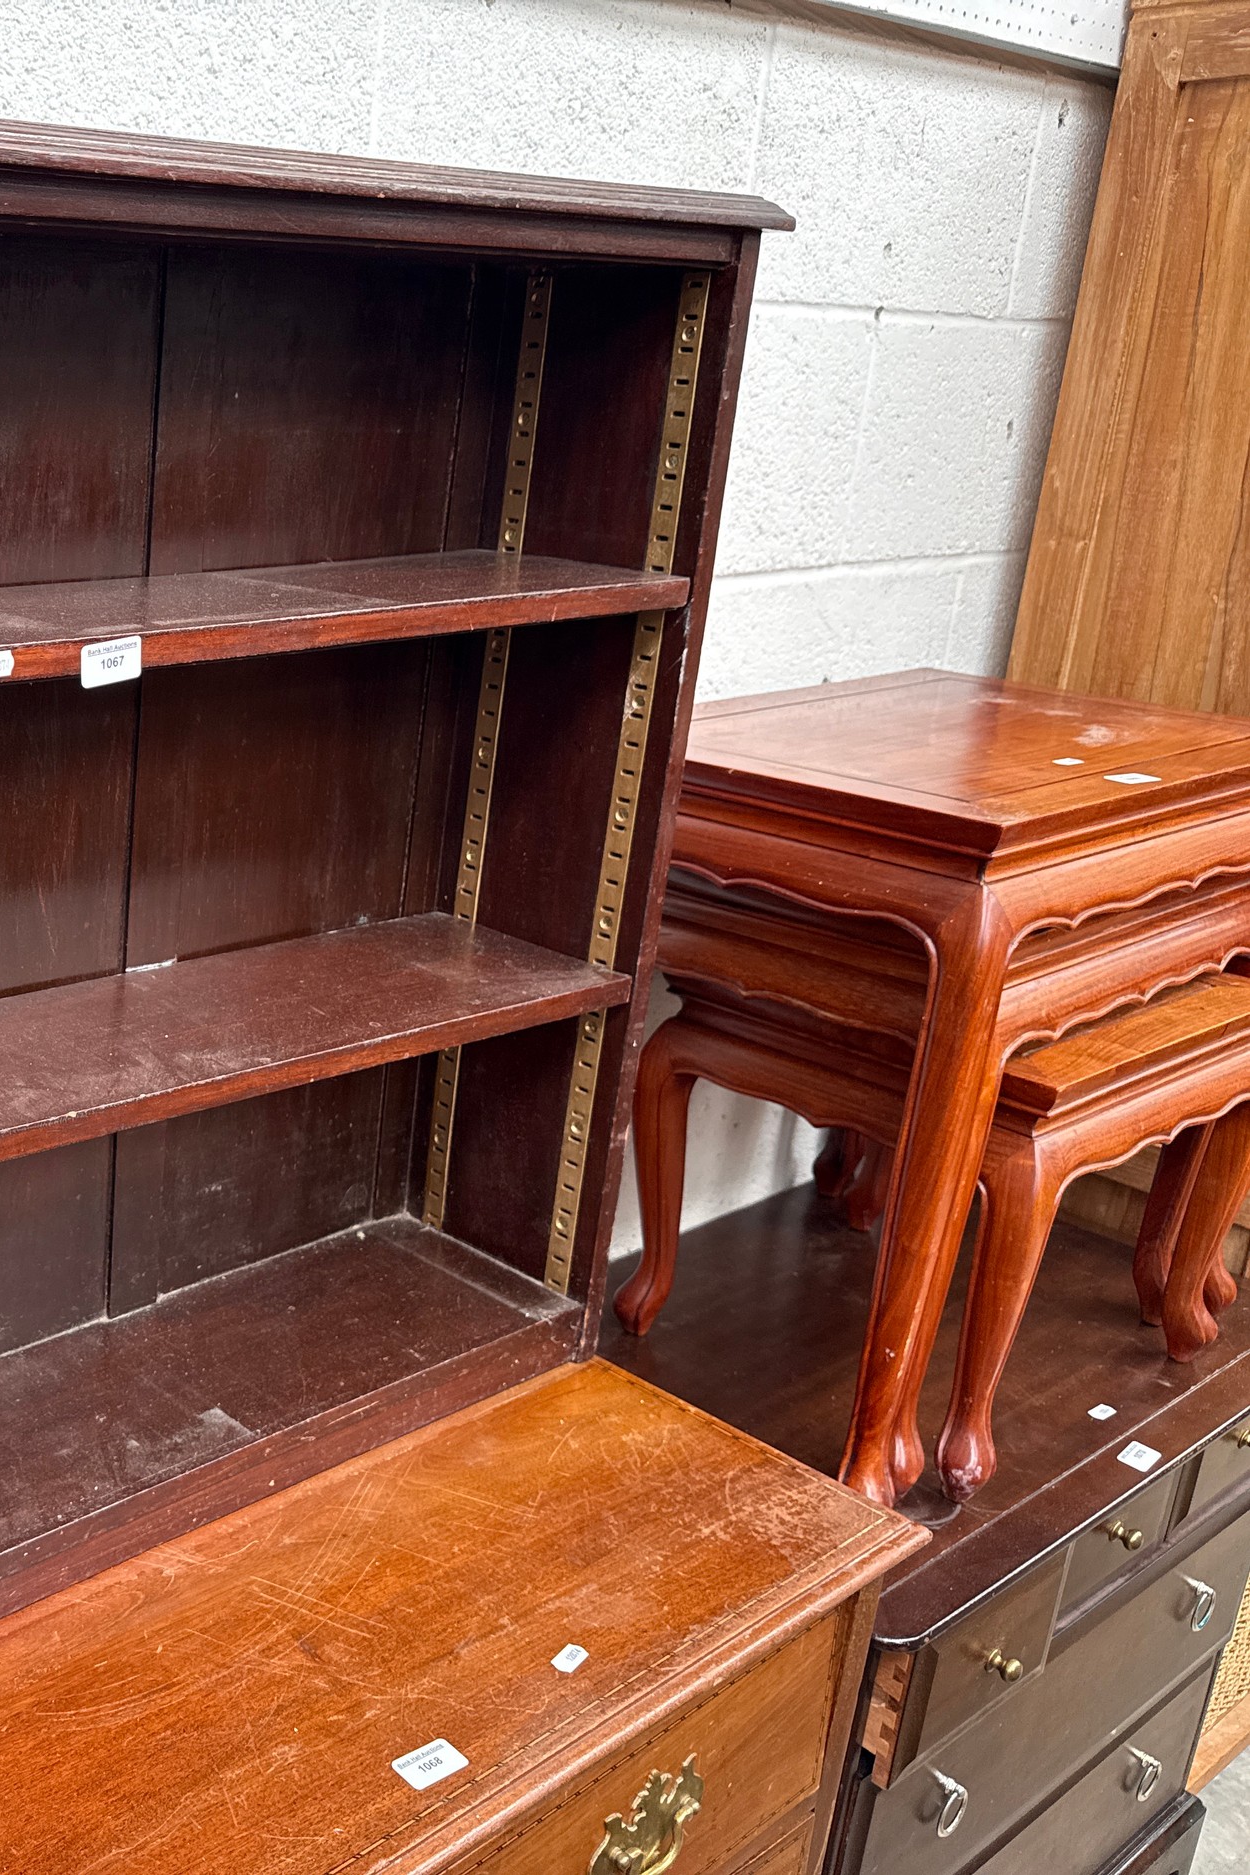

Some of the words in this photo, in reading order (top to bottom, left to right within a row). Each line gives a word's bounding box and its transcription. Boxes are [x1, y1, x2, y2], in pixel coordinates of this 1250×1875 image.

[87, 648, 101, 656] Bank
[102, 645, 114, 653] Hall
[114, 641, 137, 651] Auctions
[100, 655, 124, 670] 1067
[397, 1759, 411, 1769] Bank
[411, 1754, 422, 1763] Hall
[421, 1744, 444, 1758] Auctions
[418, 1756, 443, 1773] 1068
